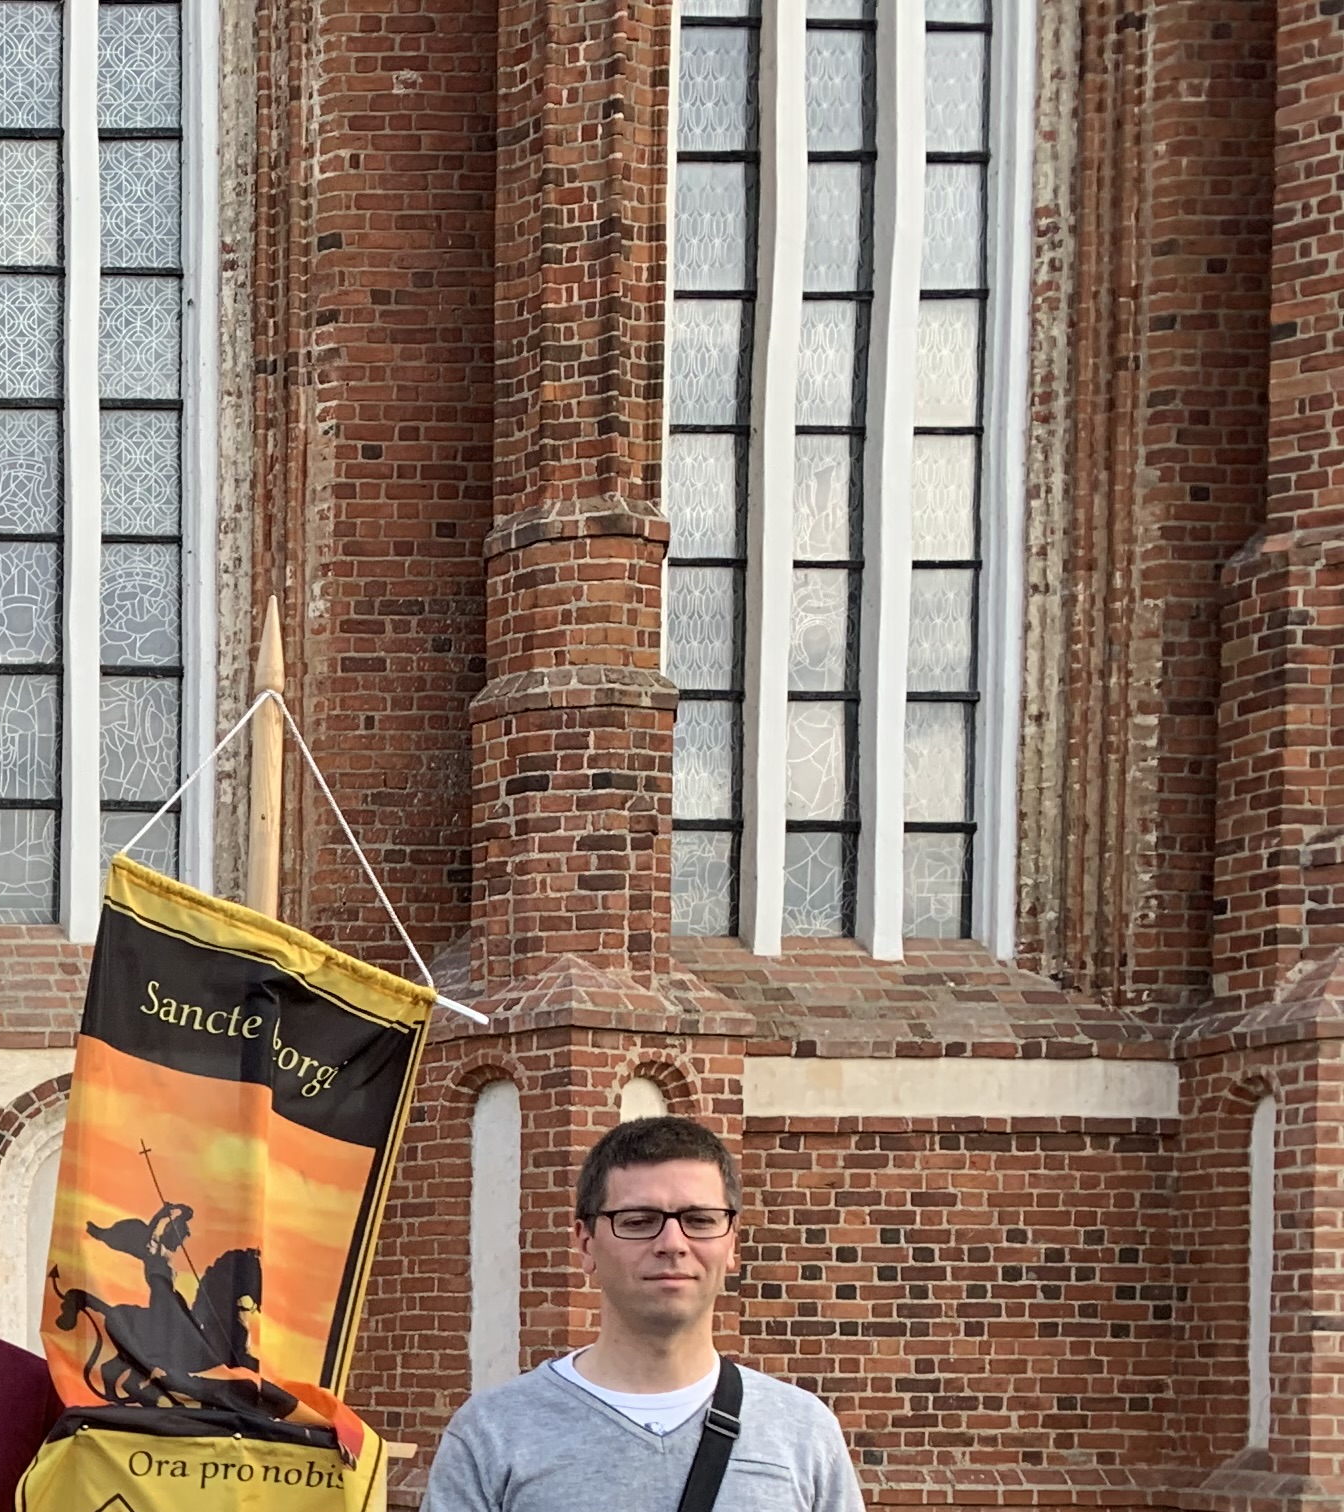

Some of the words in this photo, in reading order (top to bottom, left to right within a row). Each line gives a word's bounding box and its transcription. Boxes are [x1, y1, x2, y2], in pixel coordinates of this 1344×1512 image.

[139, 980, 263, 1040] Sancte
[128, 1450, 191, 1478] Ora
[199, 1460, 254, 1490] pro
[262, 1460, 346, 1491] nobis
